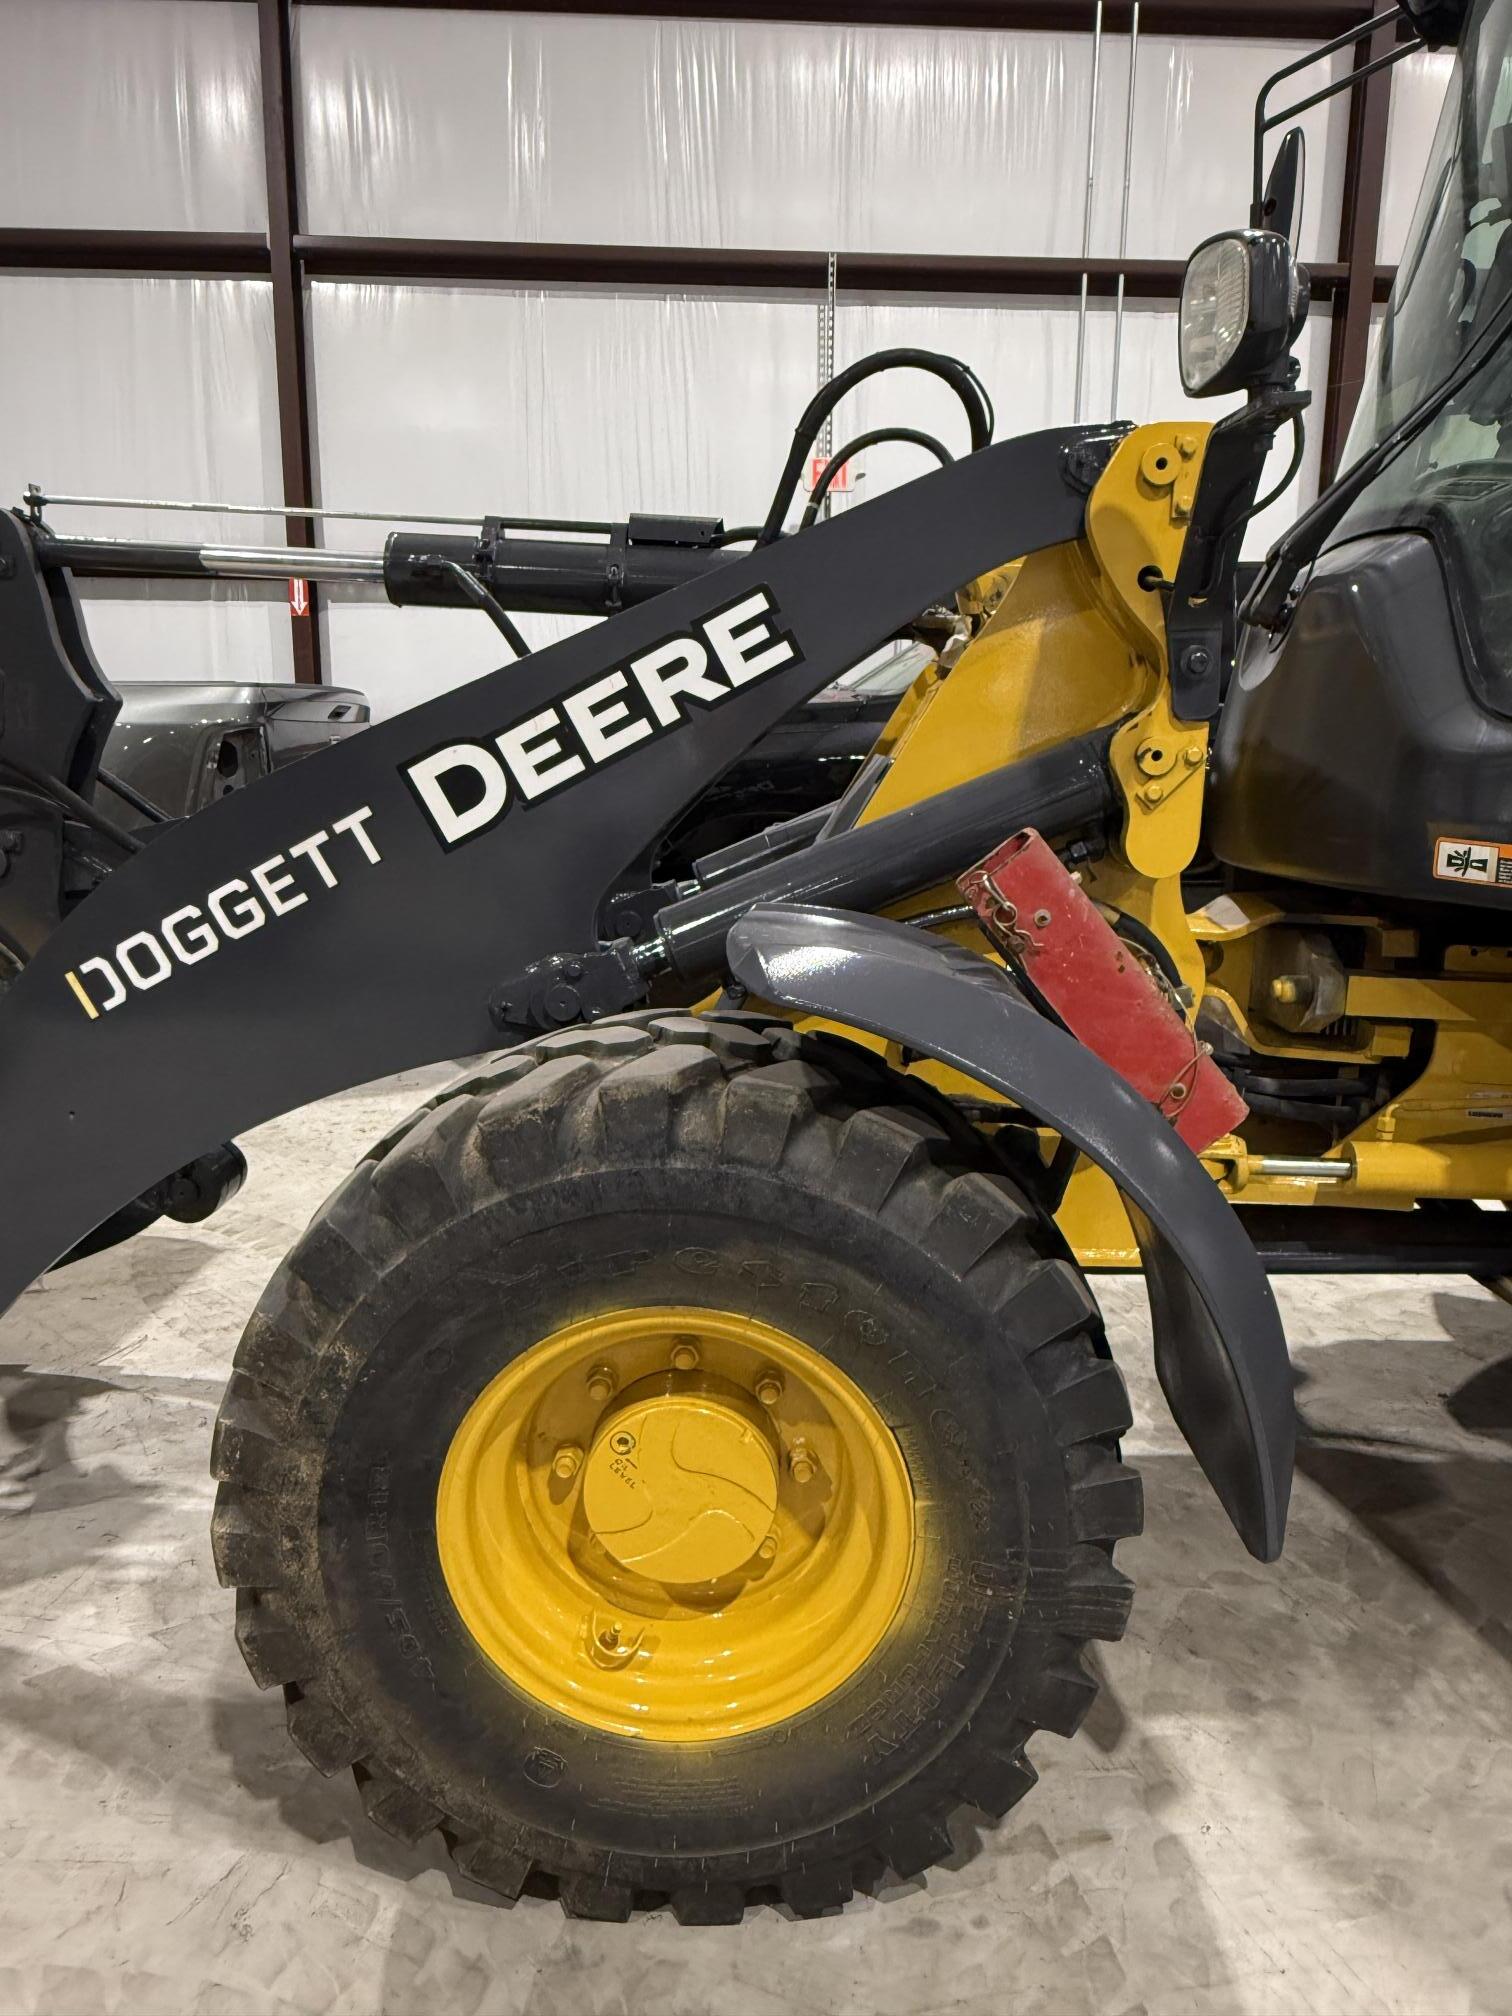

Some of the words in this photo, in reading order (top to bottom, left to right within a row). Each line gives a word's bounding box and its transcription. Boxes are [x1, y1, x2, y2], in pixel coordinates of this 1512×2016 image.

[406, 591, 793, 843] DEERE
[64, 805, 382, 1020] DOGGETT
[609, 1463, 638, 1489] LEVEL
